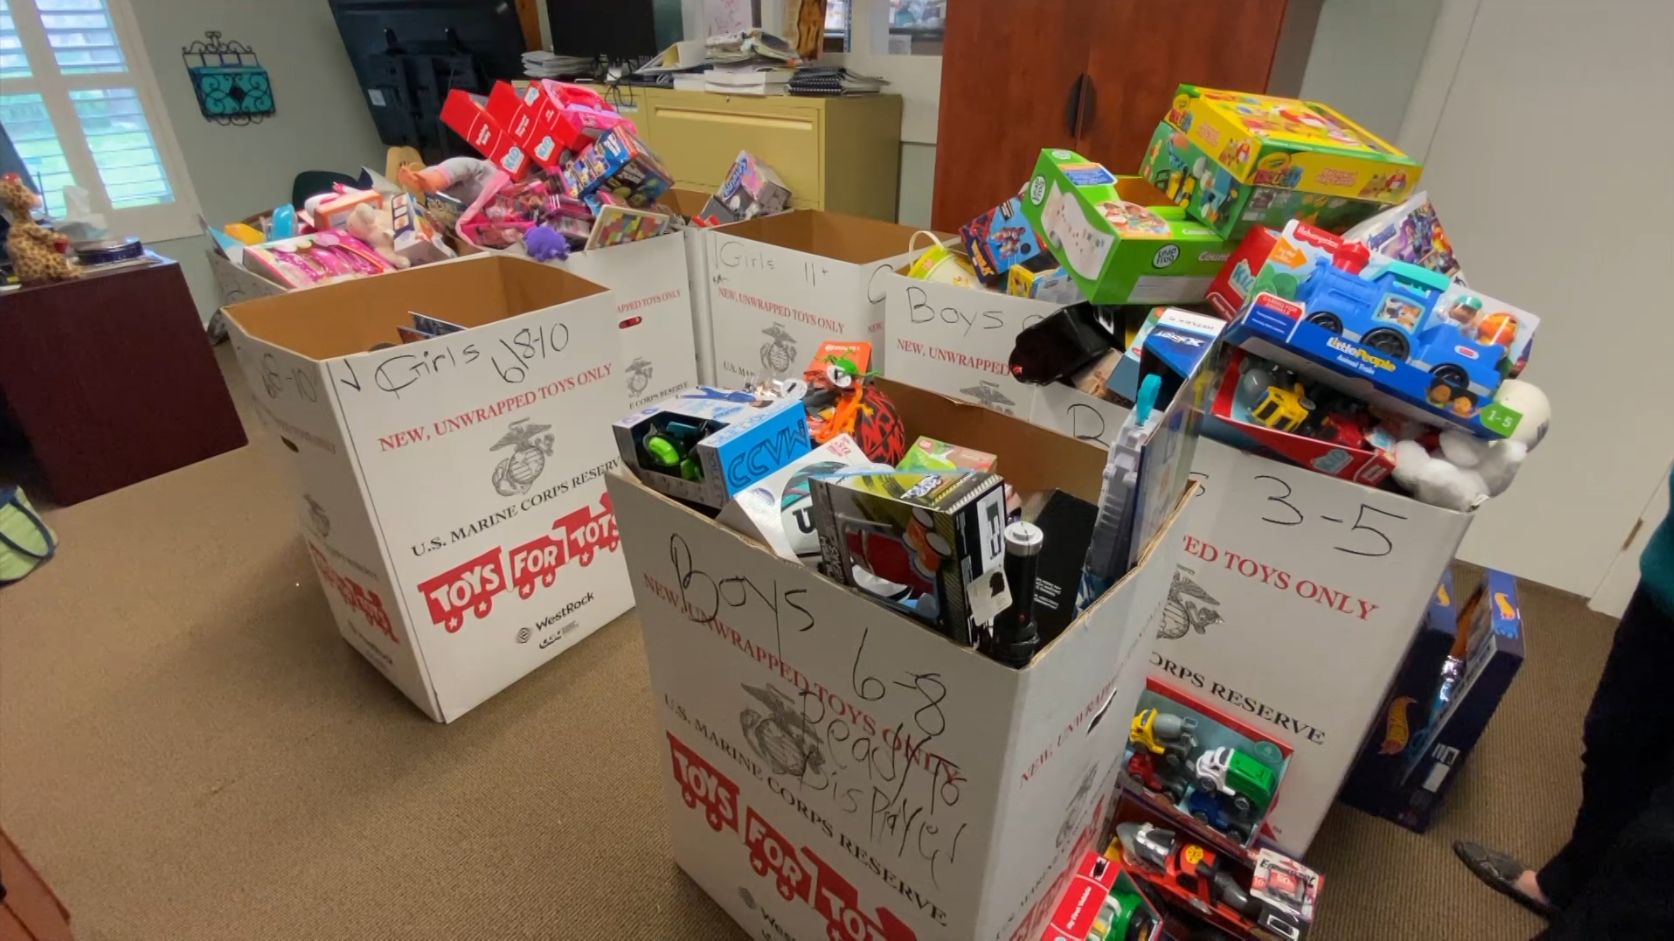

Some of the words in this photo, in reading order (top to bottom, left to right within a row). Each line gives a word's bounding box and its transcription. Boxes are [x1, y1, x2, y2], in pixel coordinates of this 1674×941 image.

[719, 240, 775, 271] Girls
[616, 300, 641, 314] APPED
[738, 293, 791, 318] UNWRAPPED
[791, 308, 817, 327] TOYS
[817, 317, 845, 334] ONLY
[906, 286, 1004, 338] Boys
[374, 343, 480, 400] Girls
[897, 339, 926, 357] NEW,
[928, 347, 1012, 378] UNWRAPPED
[378, 427, 432, 452] NEW,
[433, 391, 537, 437] UNWRAPPED
[537, 377, 576, 400] TOYS
[576, 363, 613, 388] ONLY
[411, 537, 446, 557] U.S.
[450, 504, 518, 544] MARINE
[520, 479, 570, 512] CORPS
[571, 456, 620, 489] RESERV
[1254, 475, 1408, 557] 3-5
[430, 563, 500, 612] TOYS
[513, 545, 558, 579] FOR
[535, 591, 595, 631] WestRock
[1224, 550, 1291, 590] TOYS
[1296, 579, 1379, 622] ONLY
[670, 532, 815, 661] Boys
[853, 627, 947, 737] 6-8
[814, 682, 876, 737] TOYS
[1211, 680, 1326, 746] RESERVE
[672, 749, 734, 821] TOYS
[748, 814, 803, 885] FOR
[694, 720, 764, 782] MARINE
[767, 777, 834, 838] CORPS
[839, 833, 948, 927] RESERVE
